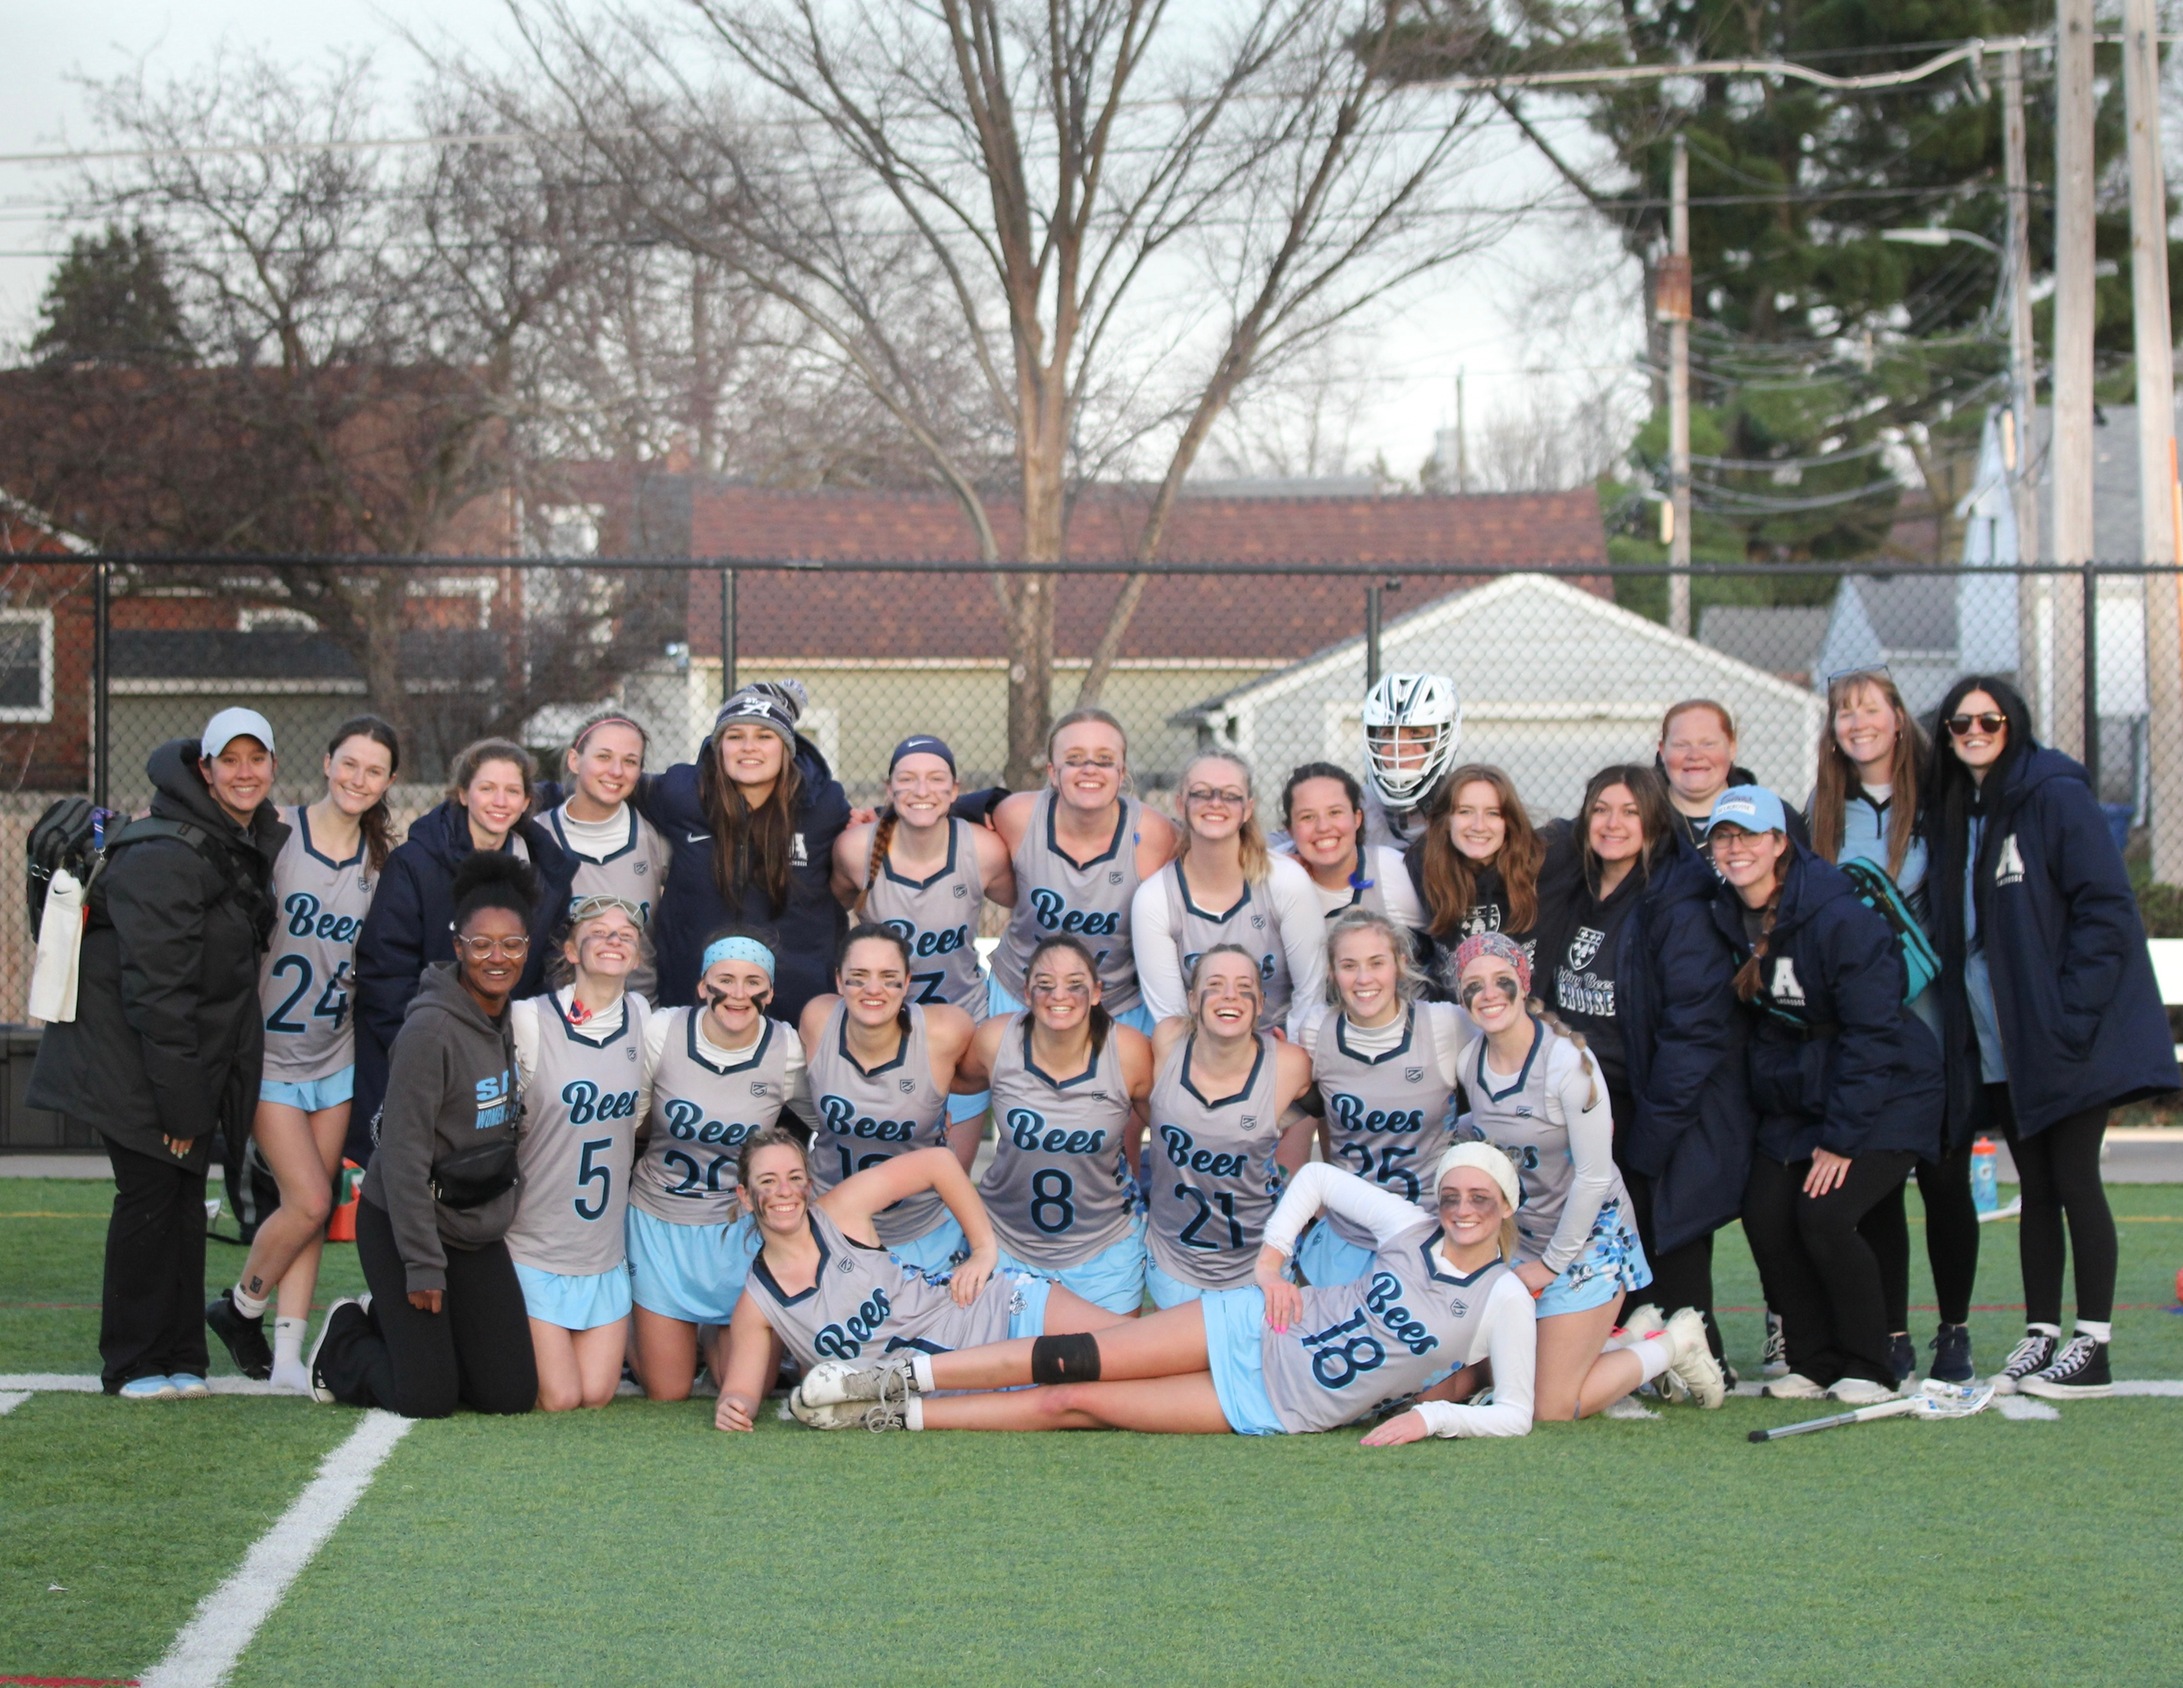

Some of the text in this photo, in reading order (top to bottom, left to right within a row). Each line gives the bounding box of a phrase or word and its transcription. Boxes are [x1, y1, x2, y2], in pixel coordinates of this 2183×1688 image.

[738, 701, 771, 718] A
[1995, 833, 2025, 880] A
[1031, 888, 1120, 935] Bees
[266, 954, 351, 1034] 24
[1558, 983, 1616, 1017] CROSSE
[1770, 957, 1805, 998] A
[562, 1079, 640, 1124] Bees
[820, 1093, 917, 1142] Bees
[1331, 1093, 1424, 1134] Bees
[1006, 1107, 1106, 1154] Bees
[1160, 1124, 1248, 1178] Bees
[574, 1137, 612, 1222] 5
[1030, 1168, 1075, 1234] 8
[1174, 1183, 1245, 1250] 21
[813, 1287, 891, 1361] Bees
[1366, 1270, 1440, 1356] Bees
[1301, 1306, 1387, 1391] 18
